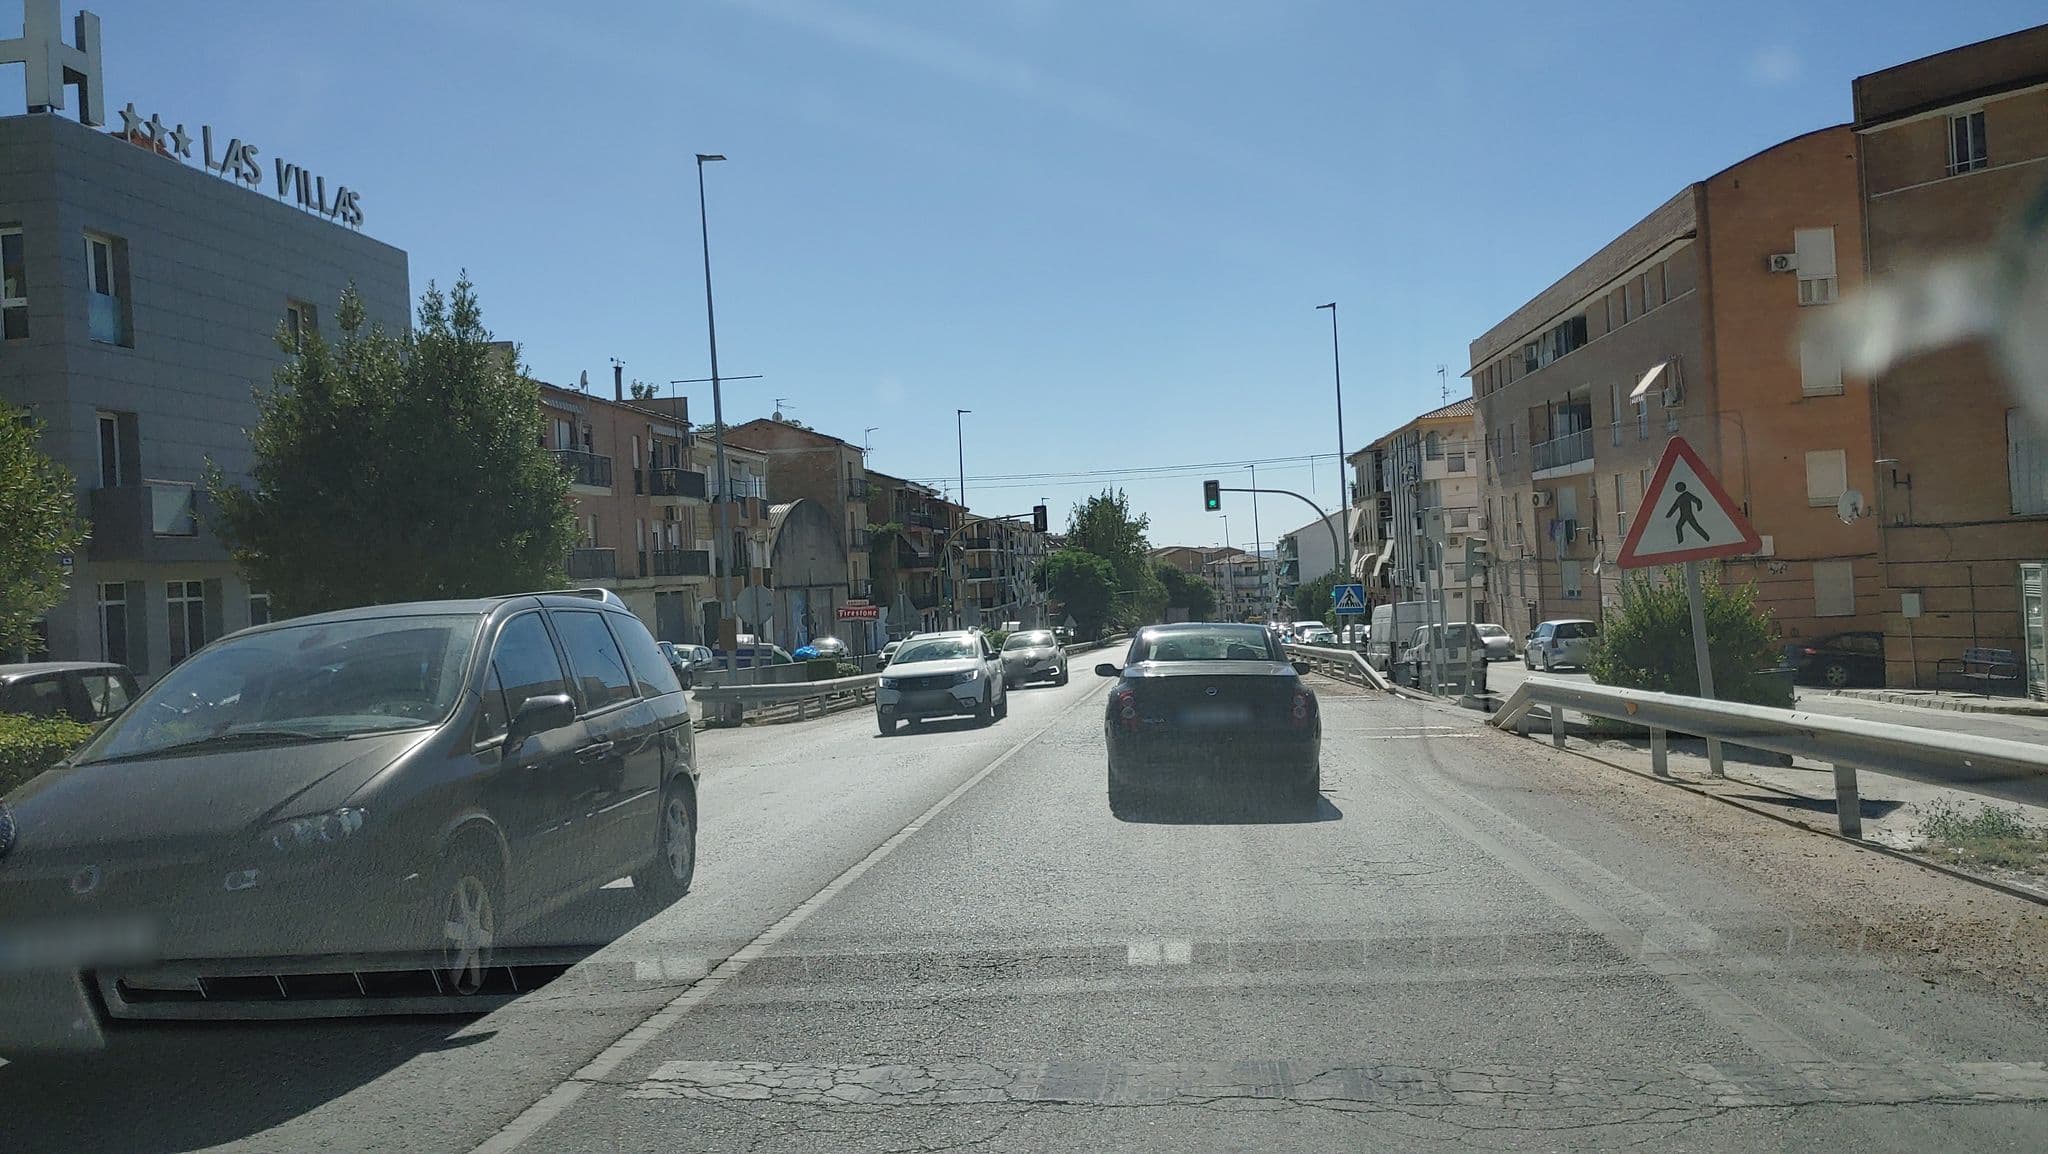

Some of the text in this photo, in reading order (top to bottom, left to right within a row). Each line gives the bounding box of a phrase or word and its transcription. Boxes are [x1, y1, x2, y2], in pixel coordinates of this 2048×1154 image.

[203, 125, 364, 226] LAS VILLAS
[838, 609, 877, 618] Firestone
